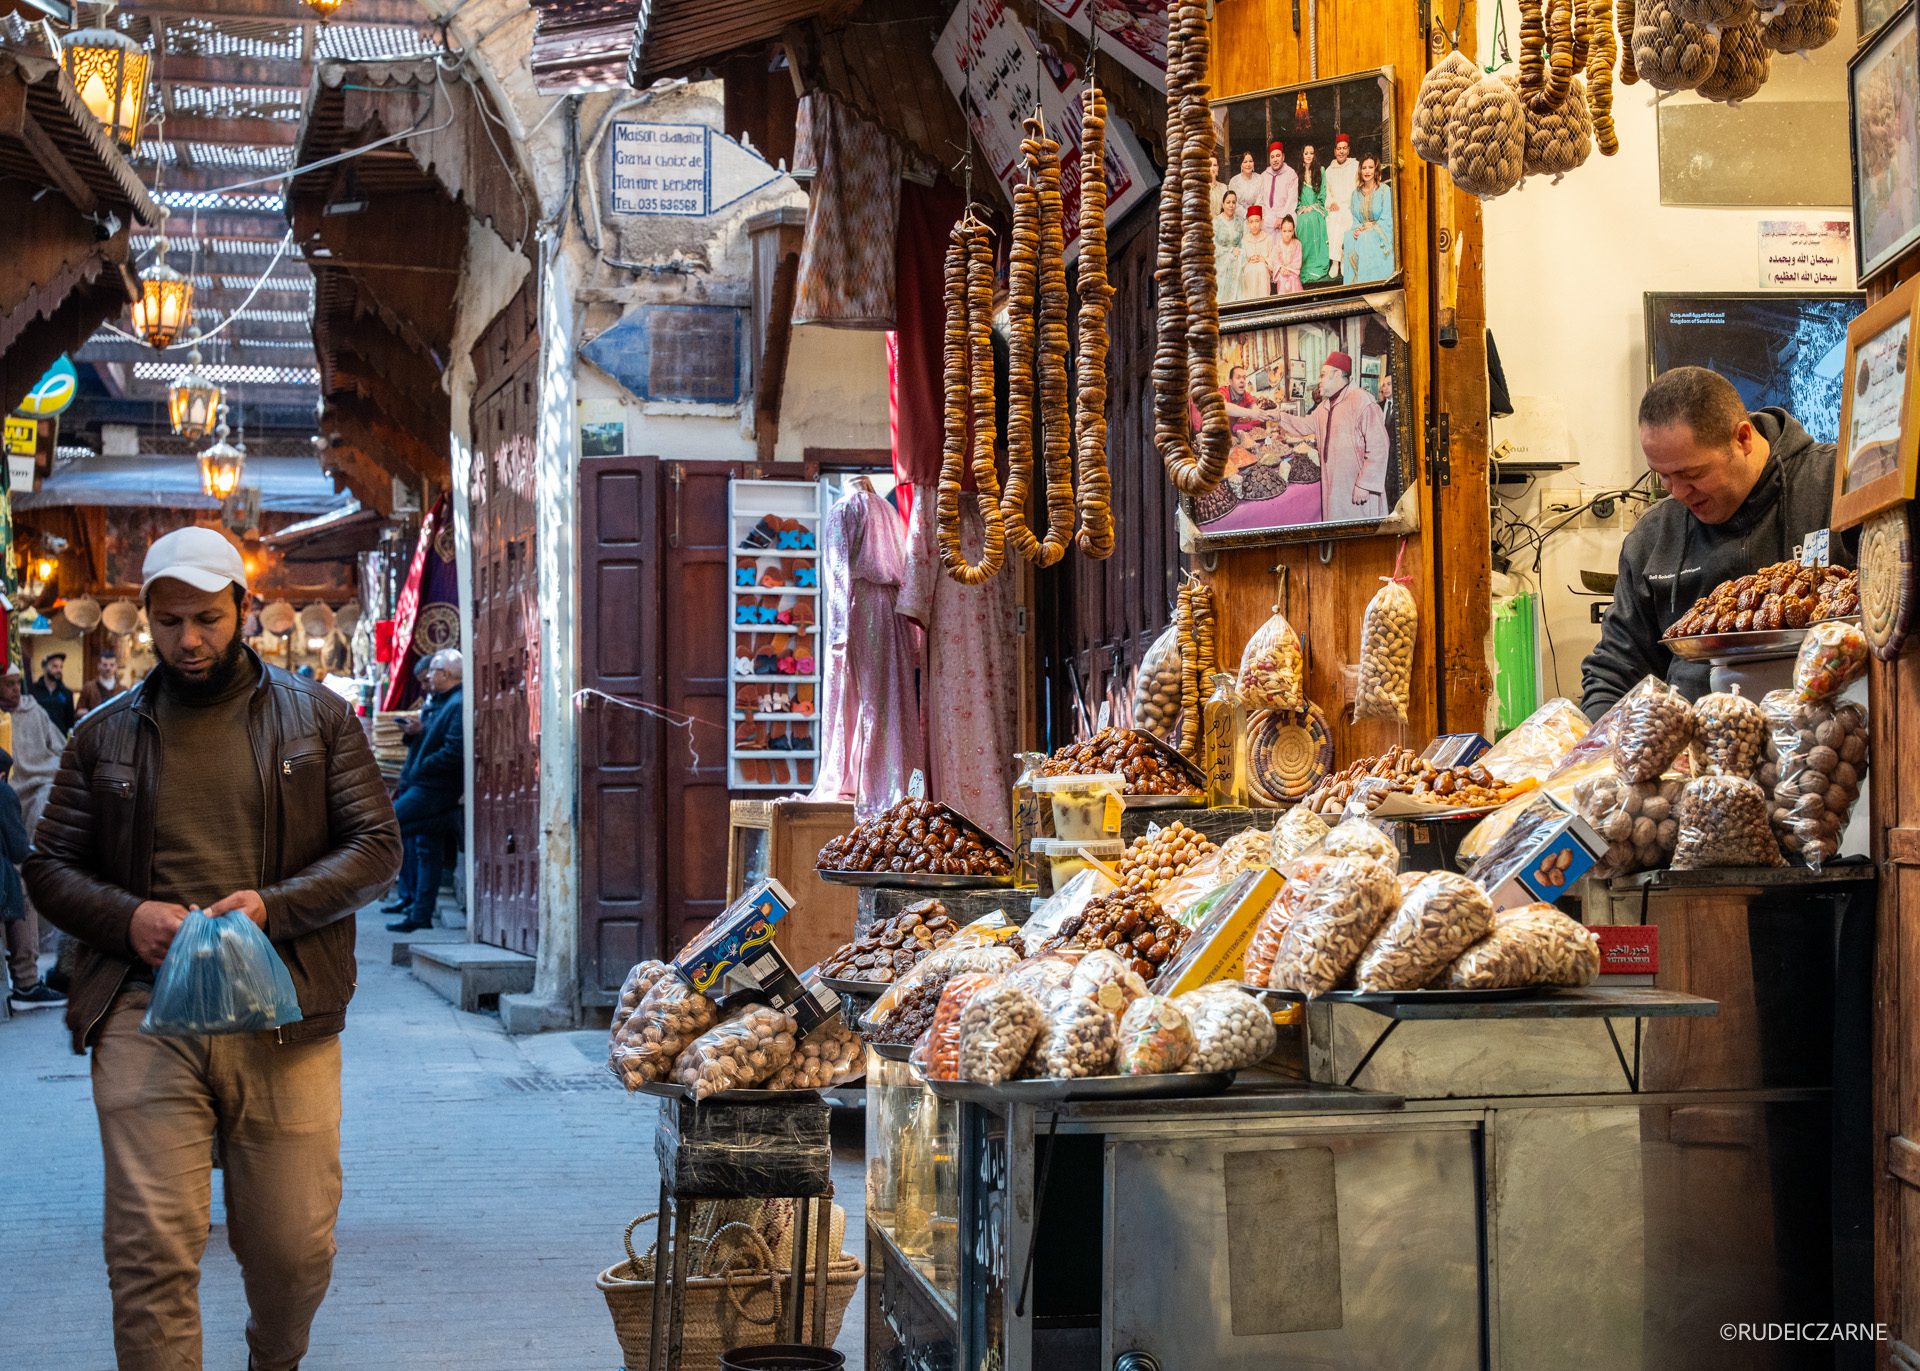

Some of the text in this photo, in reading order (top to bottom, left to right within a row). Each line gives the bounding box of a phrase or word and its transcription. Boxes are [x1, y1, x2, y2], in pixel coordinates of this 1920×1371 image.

[616, 126, 656, 143] Maison
[616, 150, 651, 165] Grand
[688, 156, 702, 167] de
[616, 175, 658, 190] Tenture
[638, 198, 657, 210] 035
[1768, 252, 1834, 267] سبحان الله وبحمده
[1774, 270, 1837, 284] سبحان الله العظيم
[1606, 945, 1649, 956] تمور الخير
